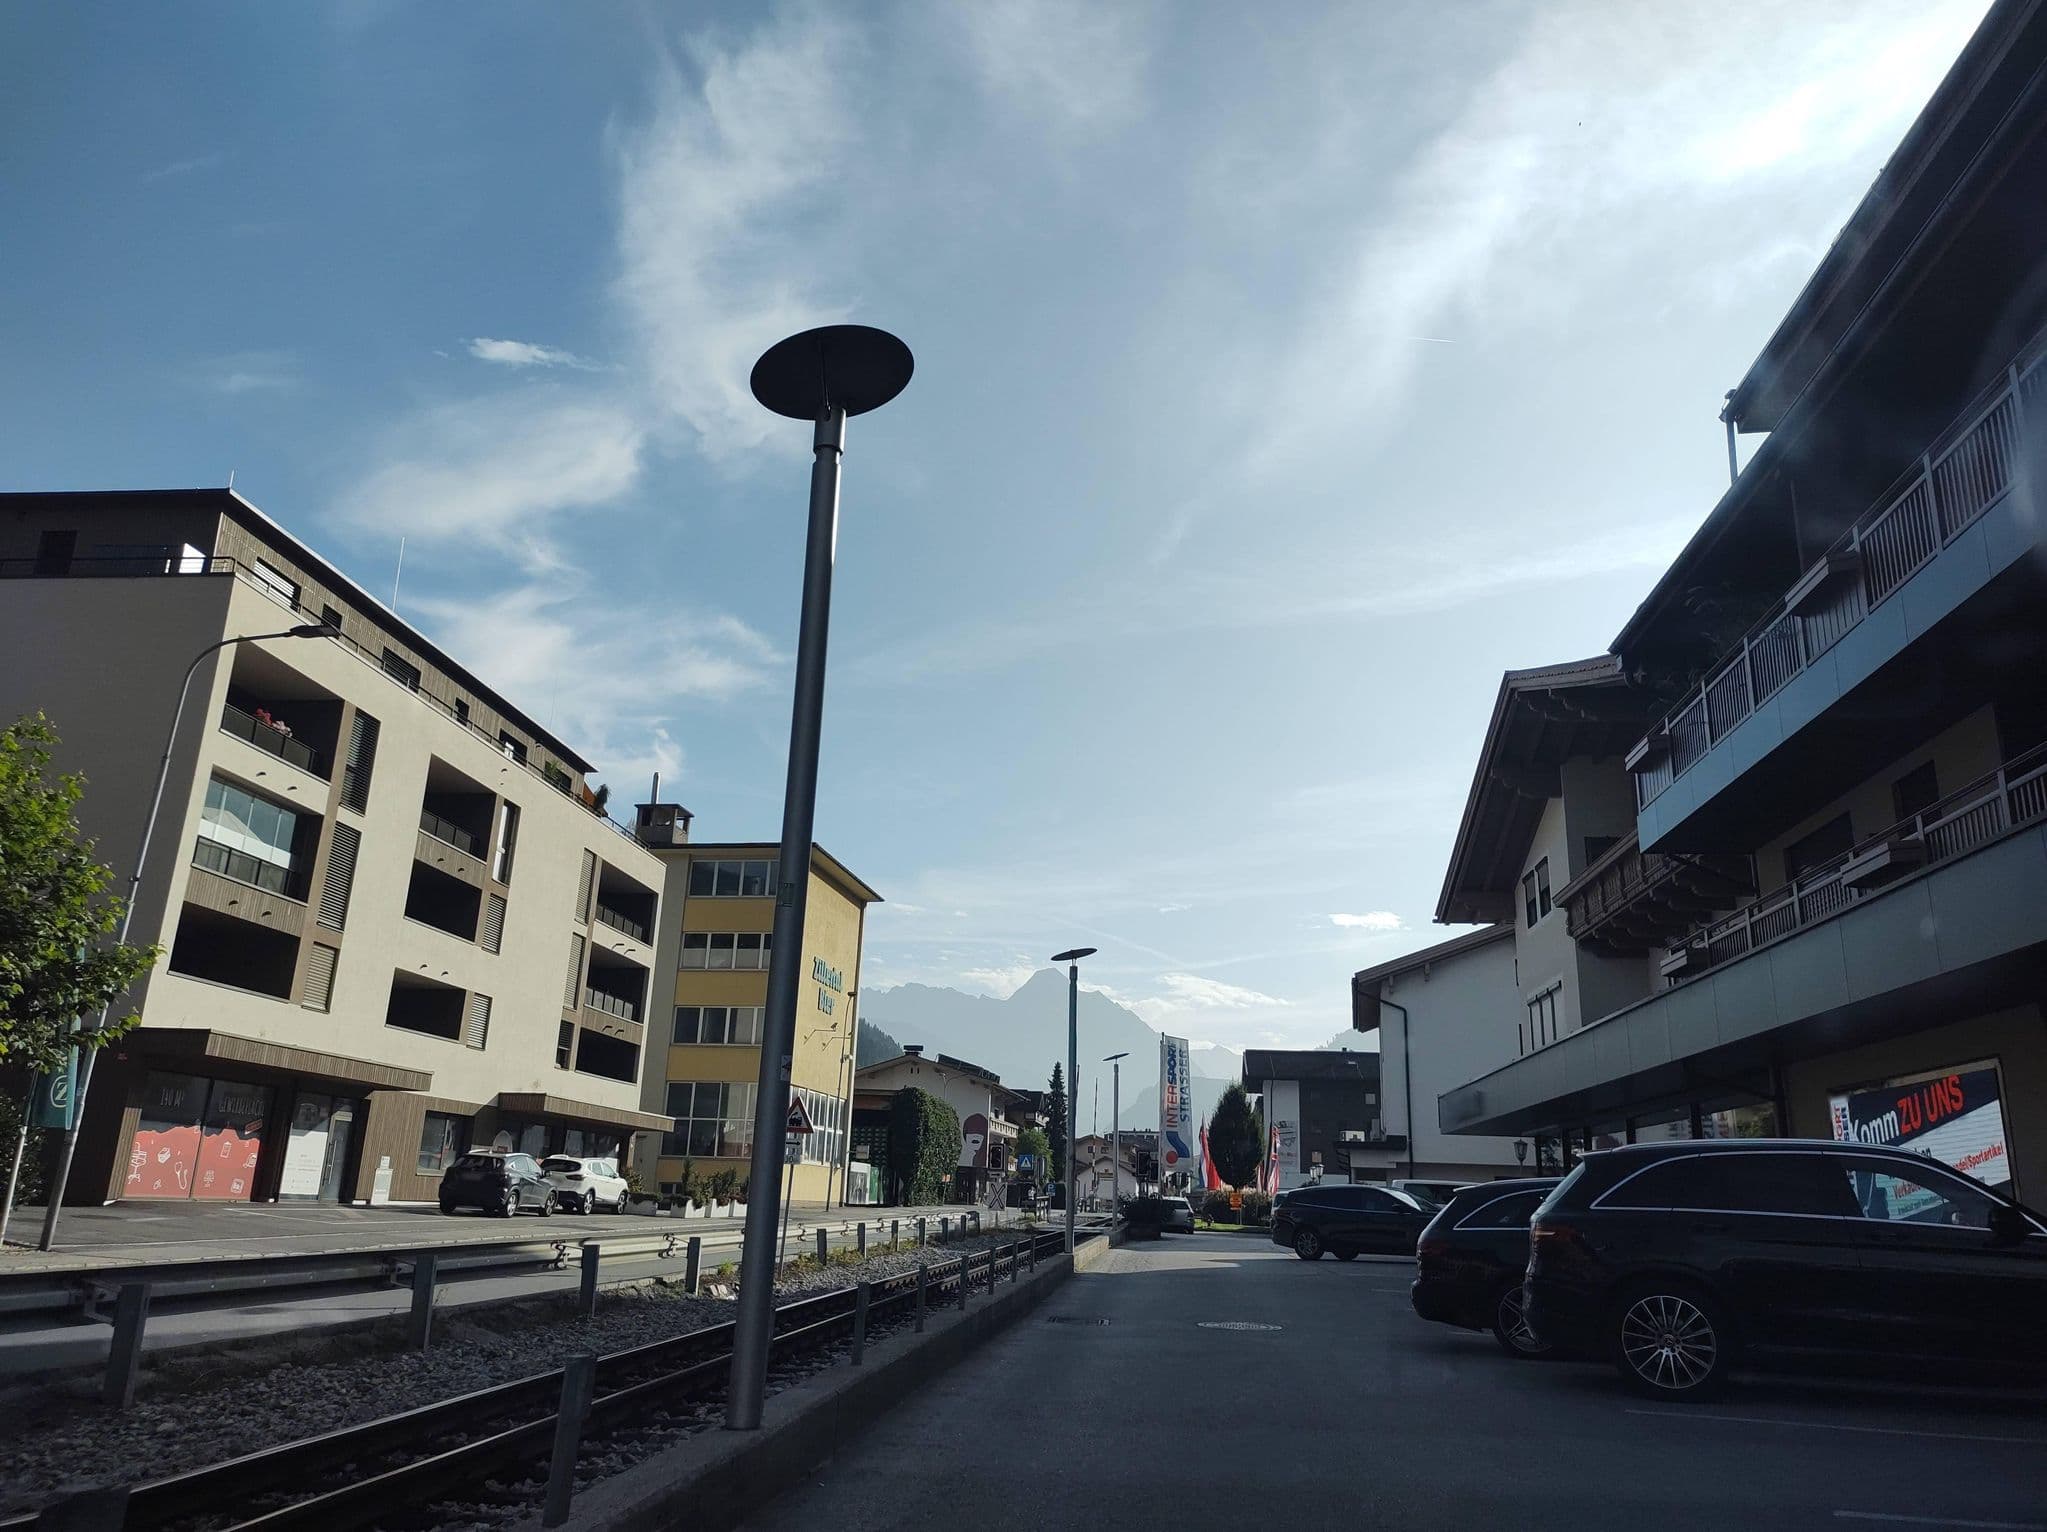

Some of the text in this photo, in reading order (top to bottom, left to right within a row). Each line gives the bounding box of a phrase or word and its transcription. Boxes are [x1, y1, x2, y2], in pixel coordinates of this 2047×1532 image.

[1167, 1042, 1178, 1128] INTERSPORT
[1179, 1049, 1190, 1122] STRASSER
[1849, 1075, 1965, 1143] Komm ZU UNS
